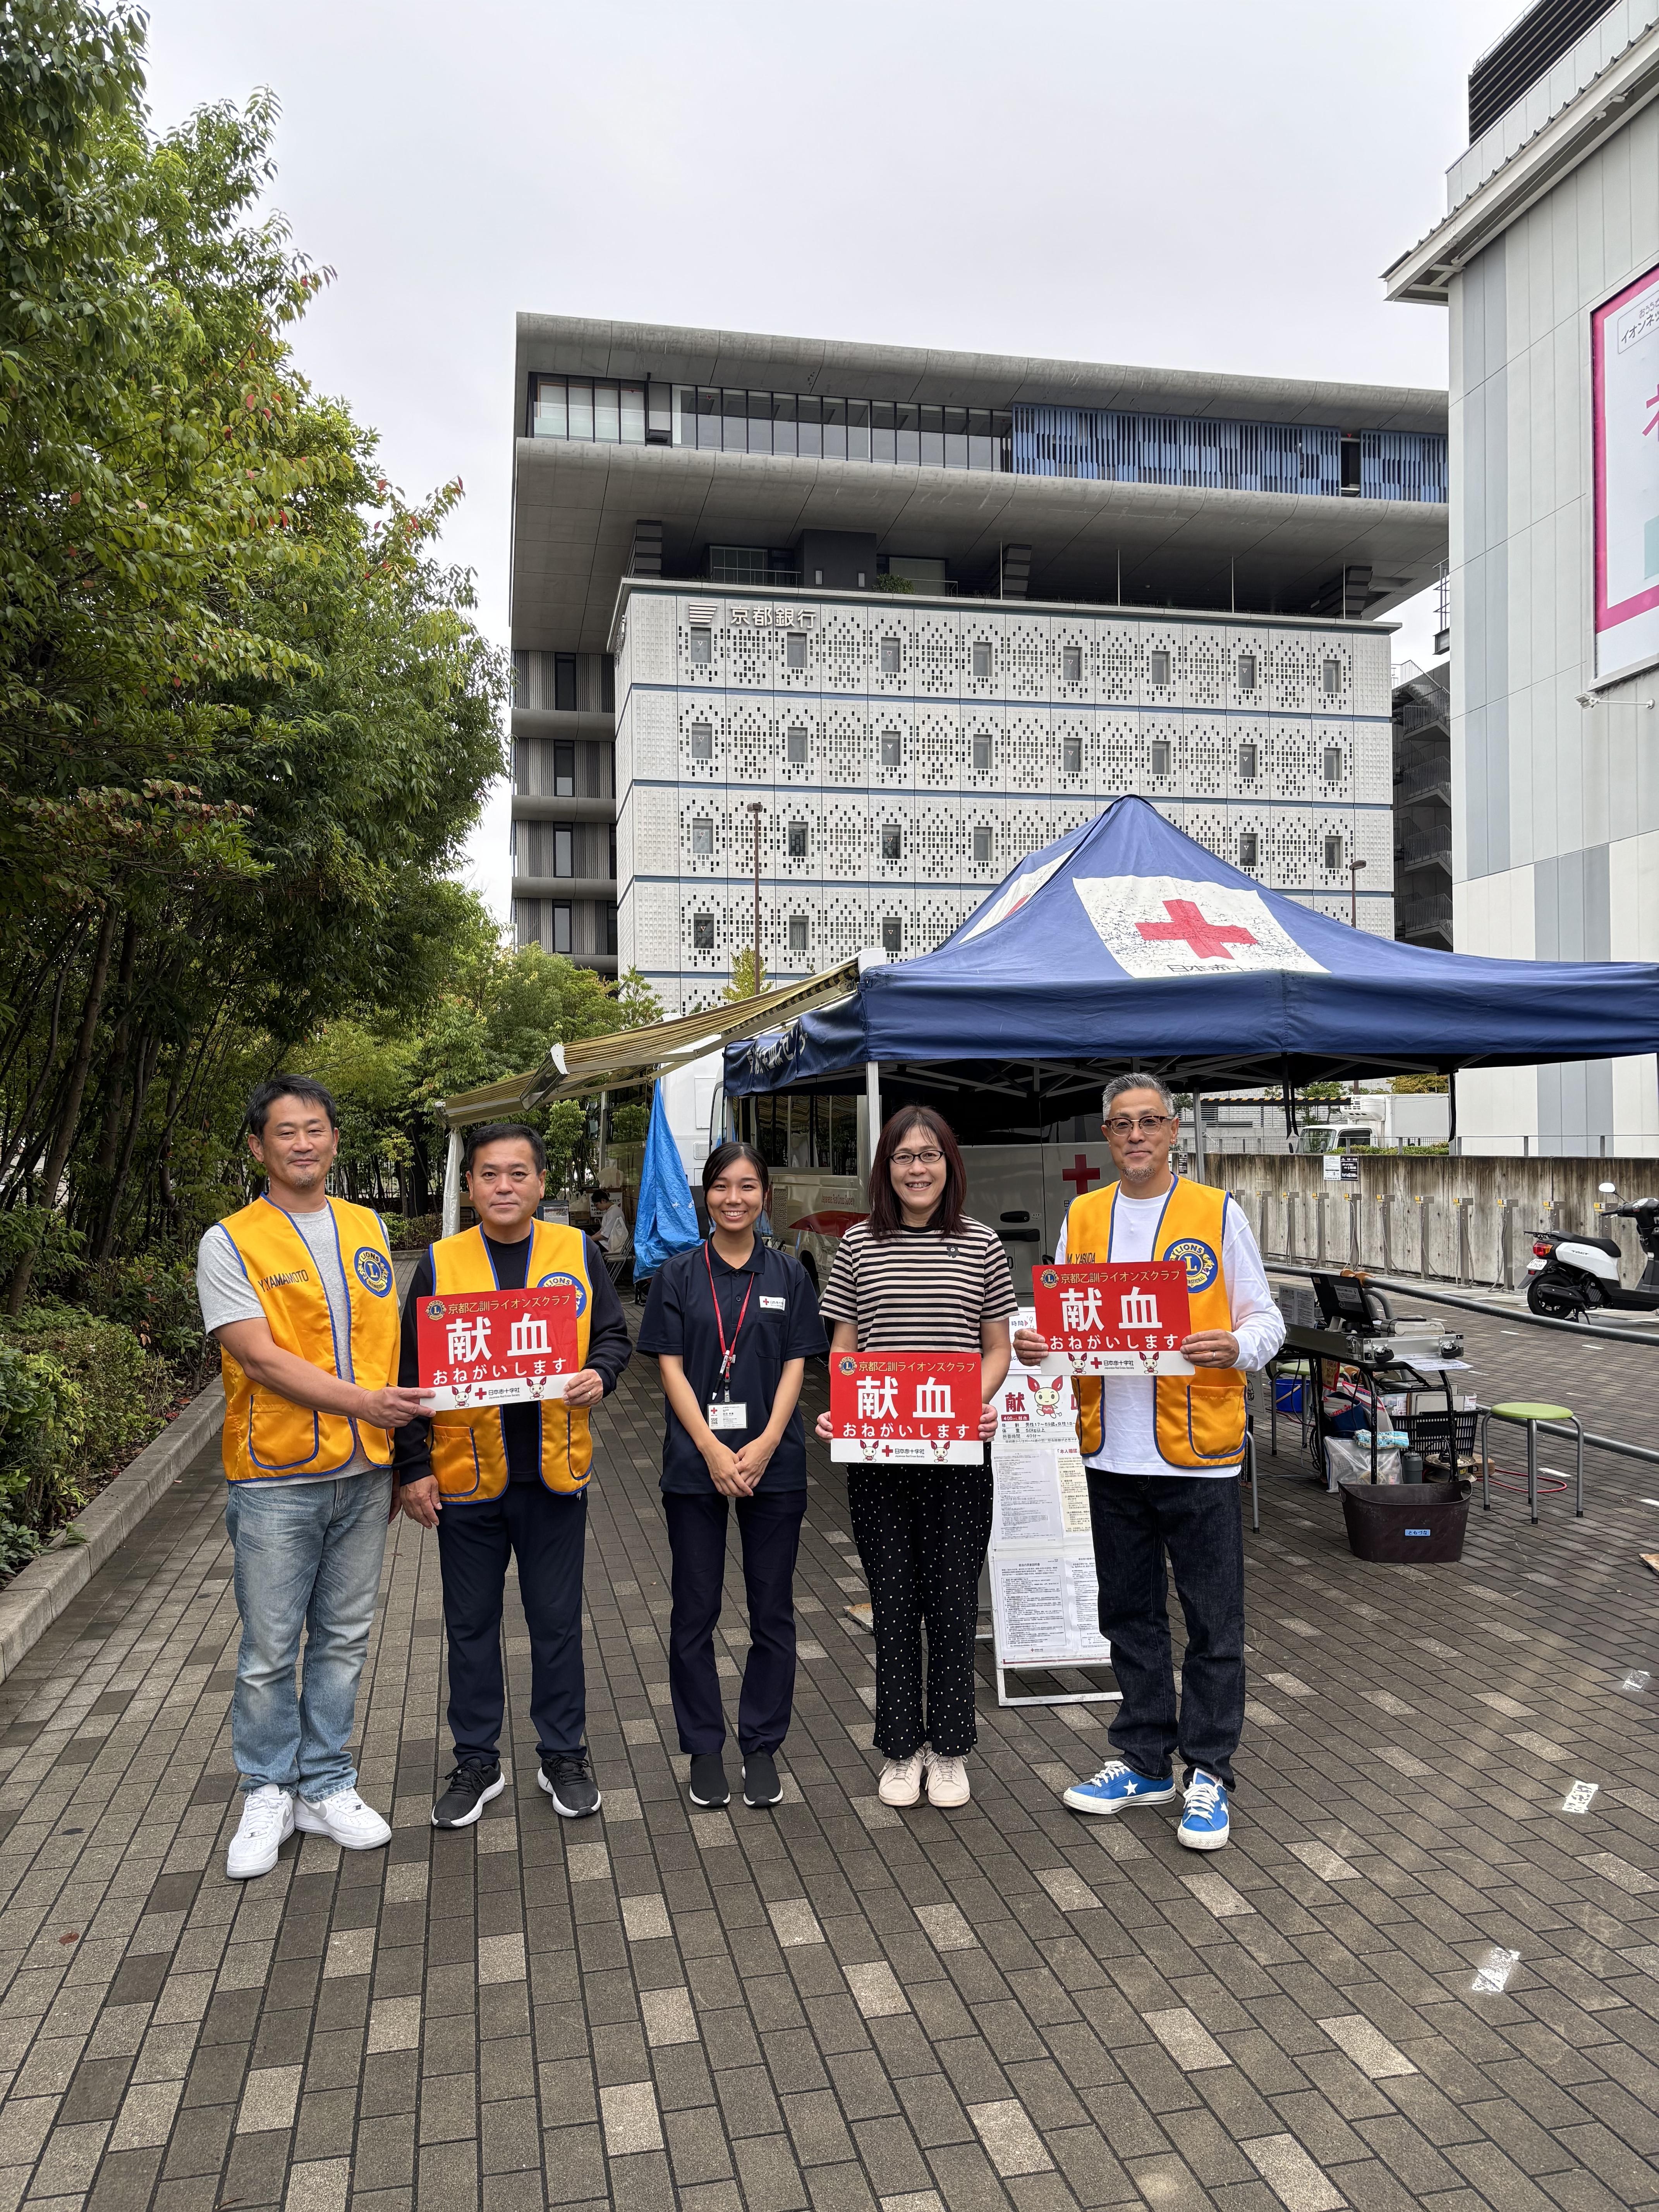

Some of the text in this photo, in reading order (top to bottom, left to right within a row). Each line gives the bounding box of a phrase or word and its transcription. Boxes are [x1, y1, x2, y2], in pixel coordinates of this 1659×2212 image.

[730, 605, 817, 629] 京都銀行
[361, 1252, 379, 1262] LIONS
[1175, 1244, 1202, 1254] LIONS
[367, 1263, 378, 1278] L
[1060, 1269, 1181, 1284] 京都乙訓ライオンズクラブ
[258, 1269, 309, 1292] Y.YAMAMOTO
[546, 1277, 570, 1287] LIONS
[448, 1293, 571, 1315] 京都乙訓ライオンズクラブ
[1059, 1286, 1163, 1333] 献血
[446, 1312, 552, 1365] 献血
[1049, 1333, 1179, 1350] おねがいします
[433, 1357, 567, 1386] おねがいします
[859, 1361, 976, 1372] 京都乙訓ライオンズクラブ
[856, 1375, 956, 1420] 献血
[843, 1422, 970, 1438] おねがいします
